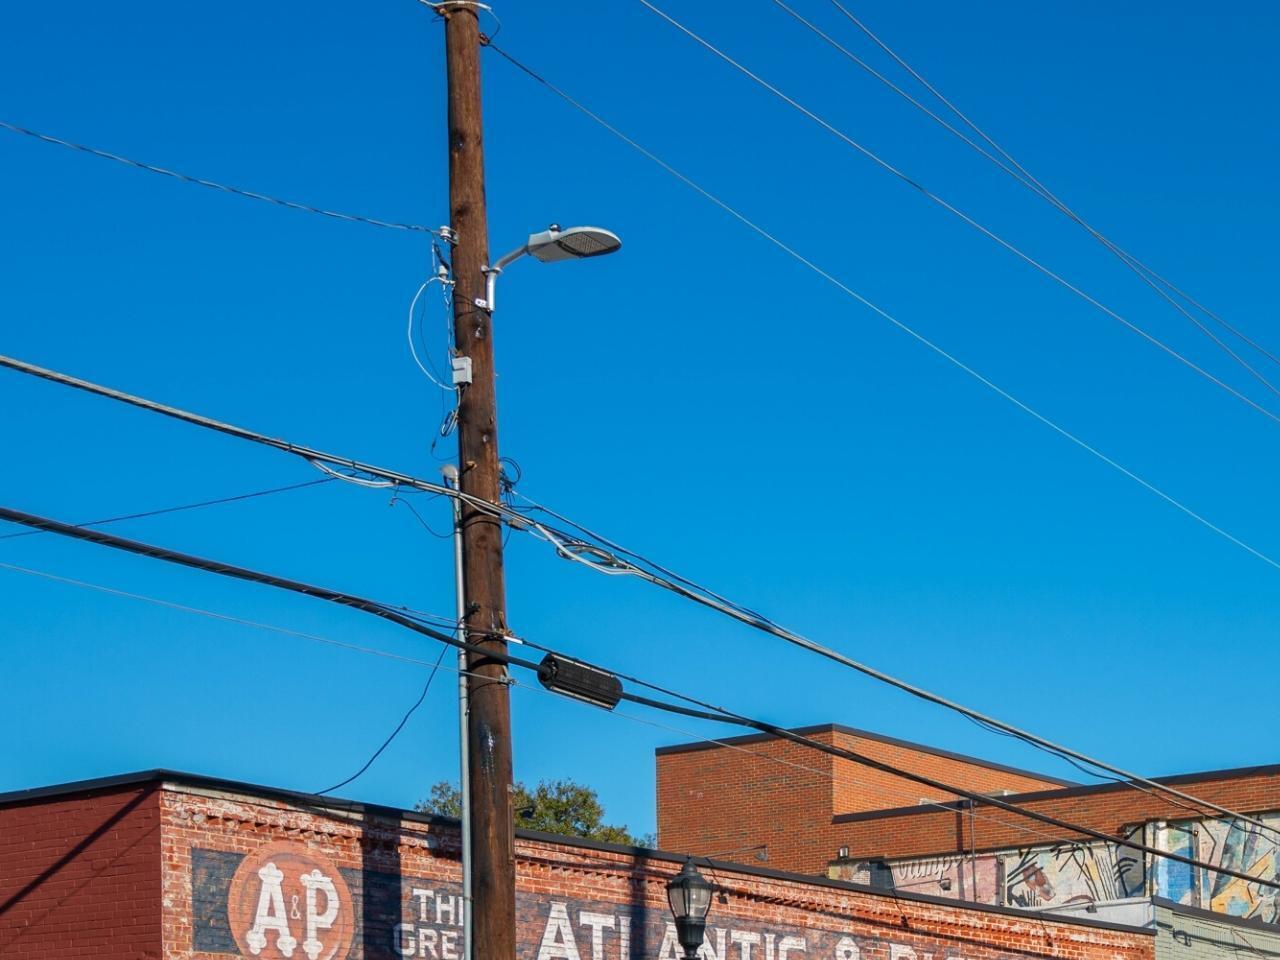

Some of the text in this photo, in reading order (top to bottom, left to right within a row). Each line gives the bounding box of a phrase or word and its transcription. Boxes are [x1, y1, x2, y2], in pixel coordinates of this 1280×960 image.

[246, 862, 340, 960] A&P
[412, 888, 465, 927] TH
[394, 922, 465, 960] GRE
